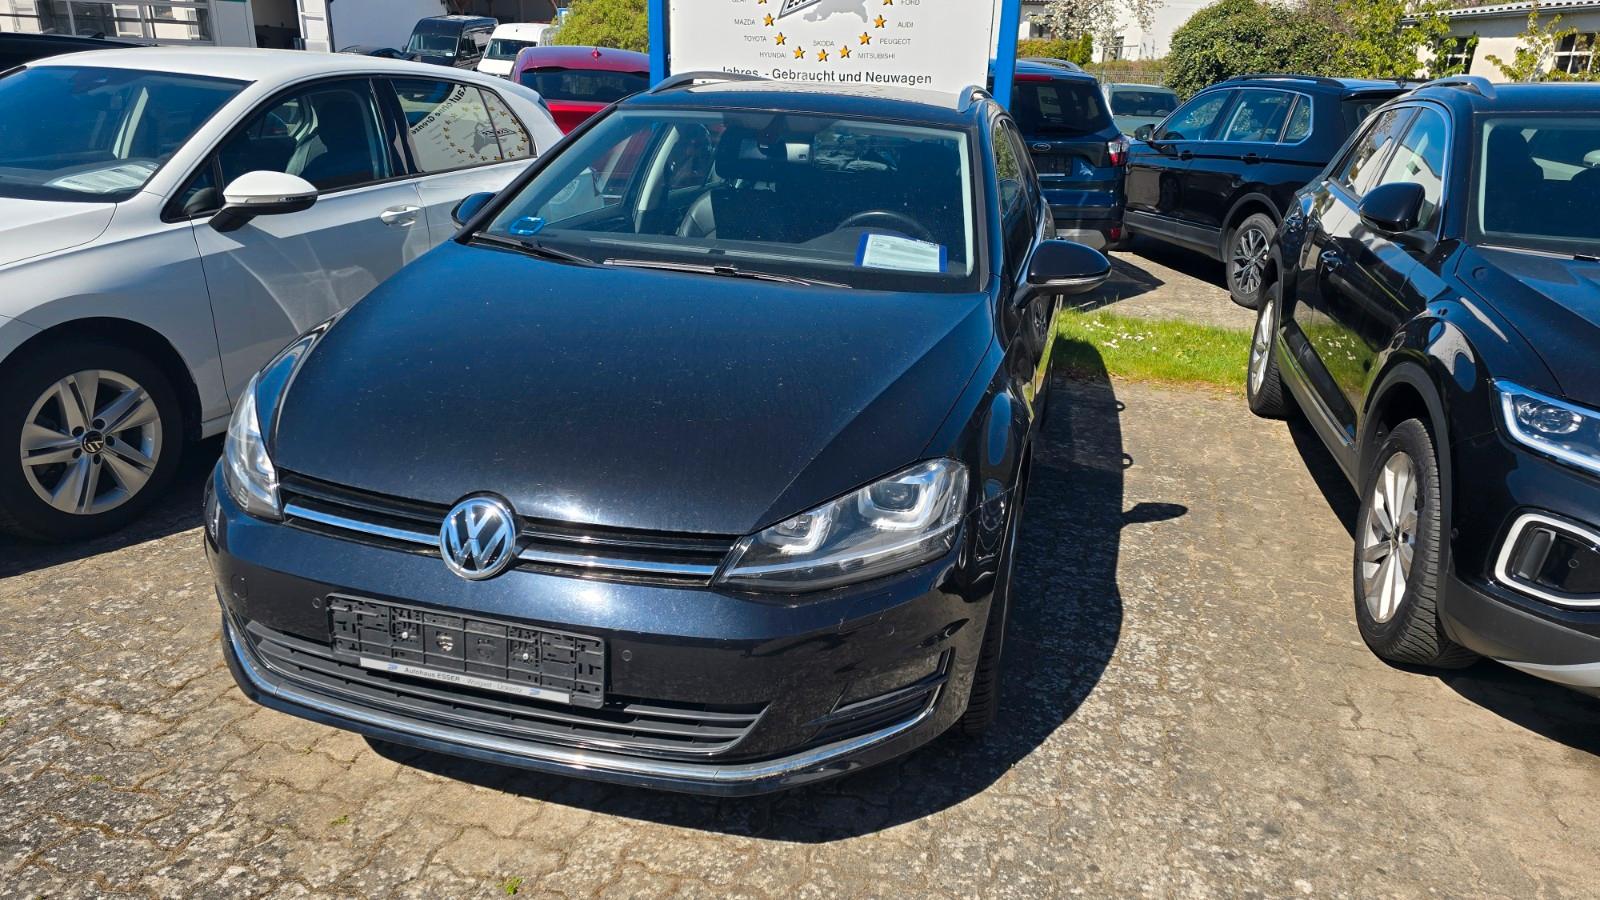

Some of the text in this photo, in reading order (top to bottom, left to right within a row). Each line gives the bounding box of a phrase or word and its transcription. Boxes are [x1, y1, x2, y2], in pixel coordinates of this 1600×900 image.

[772, 68, 836, 82] Gebraucht
[838, 71, 862, 82] und
[865, 71, 932, 85] Neuwagen
[404, 667, 436, 678] Autohaus
